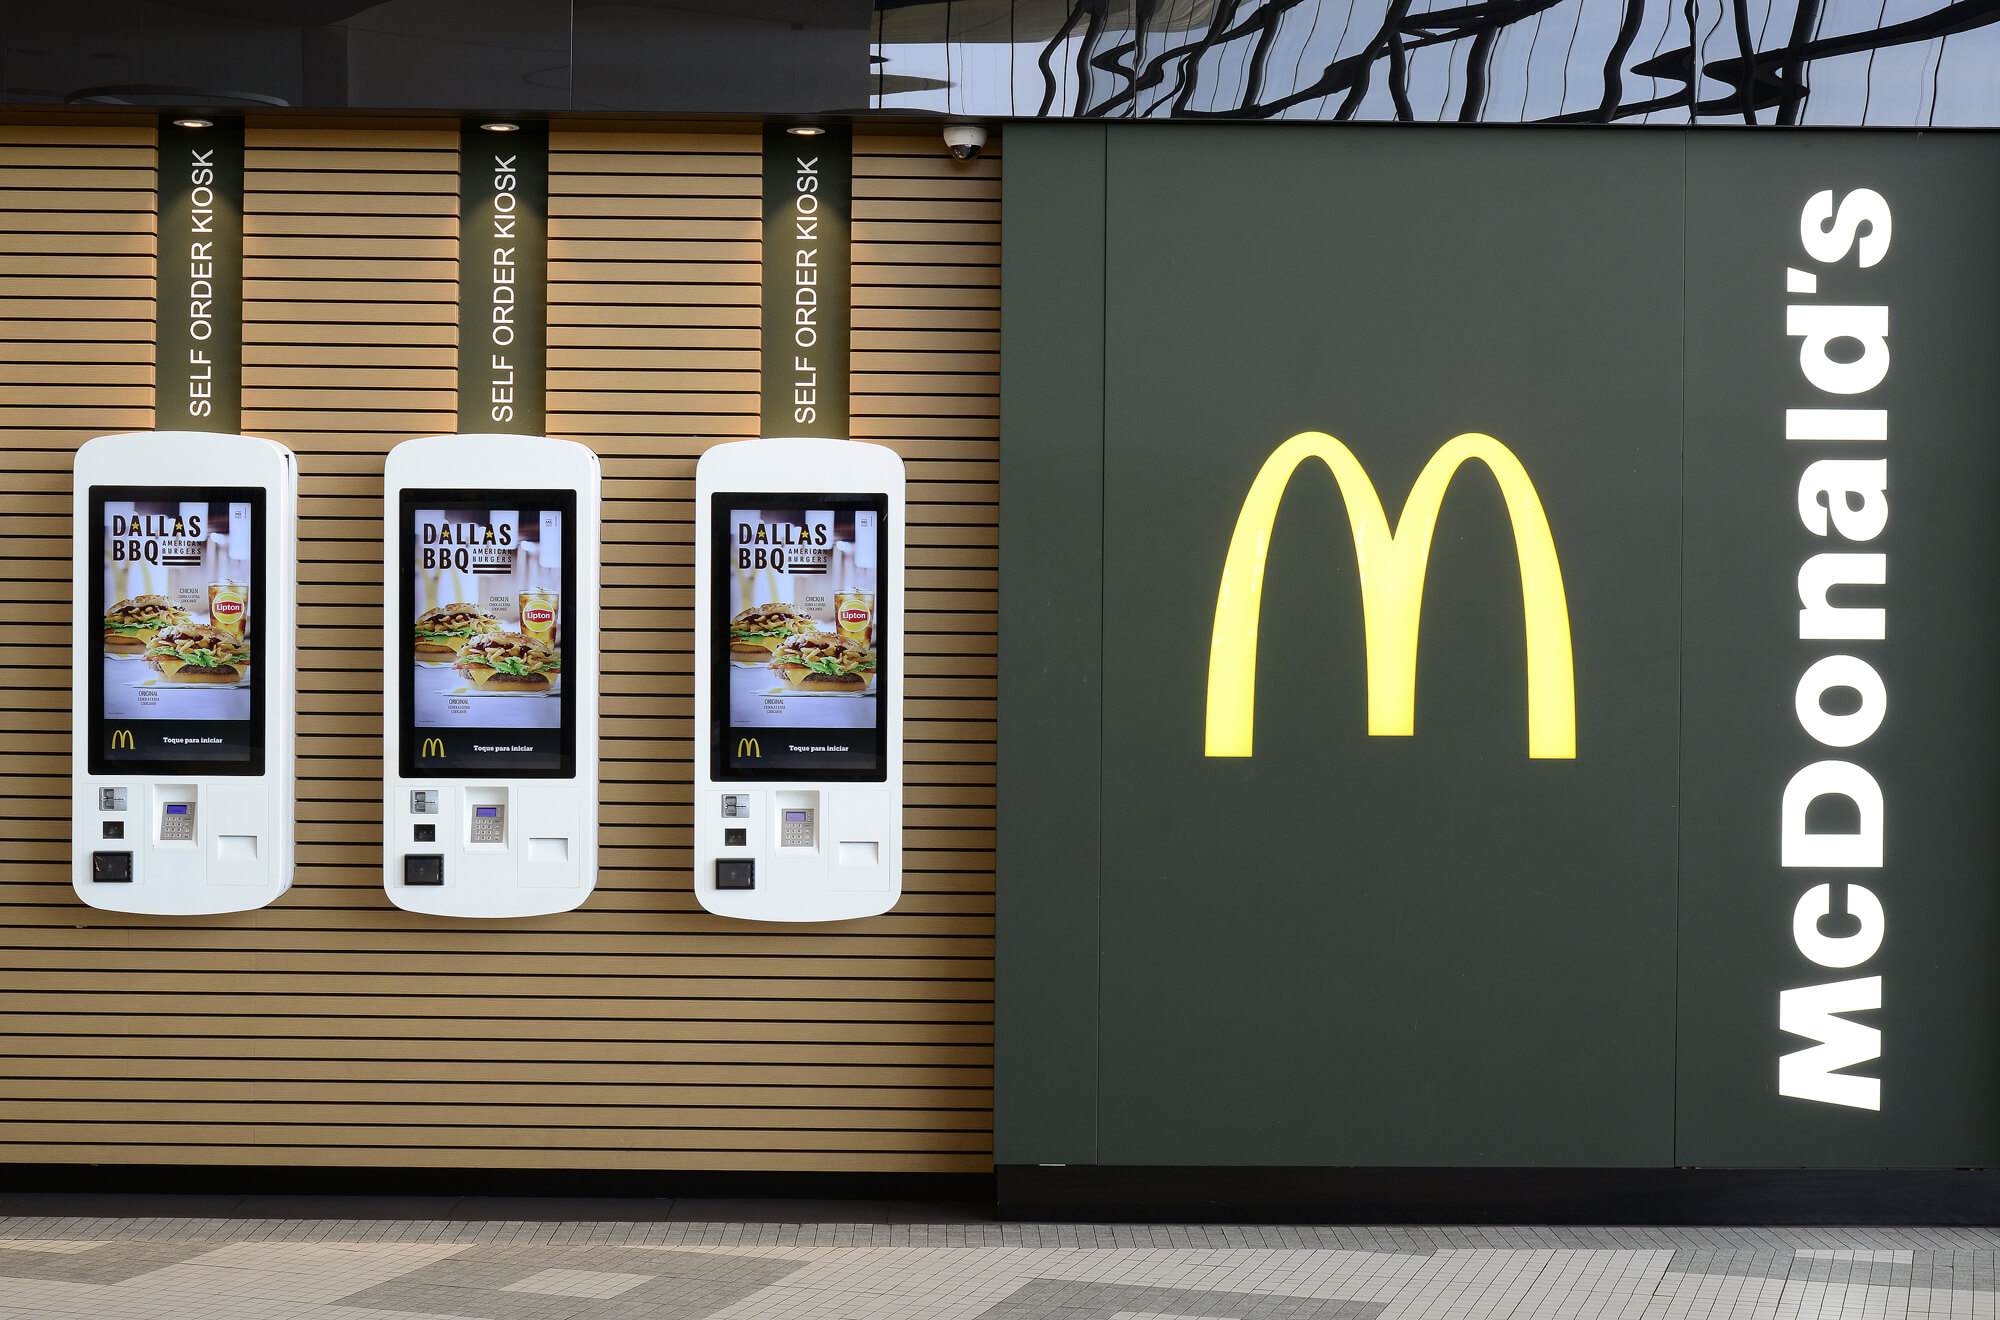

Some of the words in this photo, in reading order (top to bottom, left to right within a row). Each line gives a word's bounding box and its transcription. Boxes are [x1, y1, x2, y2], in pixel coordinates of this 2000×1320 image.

[191, 149, 214, 233] KIOSK
[493, 155, 517, 239] KIOSK
[795, 156, 819, 240] KIOSK
[189, 241, 213, 342] ORDER
[492, 246, 516, 346] ORDER
[794, 248, 818, 348] ORDER
[189, 348, 212, 418] SELF
[491, 354, 515, 423] SELF
[793, 355, 817, 425] SELF
[112, 515, 201, 537] DALLAS
[423, 523, 512, 545] DALLAS
[738, 523, 827, 545] DALLAS
[112, 540, 158, 565] BBQ
[423, 548, 469, 573] BBQ
[738, 548, 784, 573] BBQ
[216, 604, 240, 614] Lipton
[527, 612, 551, 622] Lipton
[842, 611, 866, 621] Lipton
[1778, 187, 1893, 1112] McDonald's
[162, 736, 184, 745] Toque
[200, 736, 223, 744] iniciar
[473, 744, 495, 753] Toque
[511, 744, 534, 752] iniciar
[788, 744, 810, 753] Toque
[826, 744, 849, 752] iniciar
